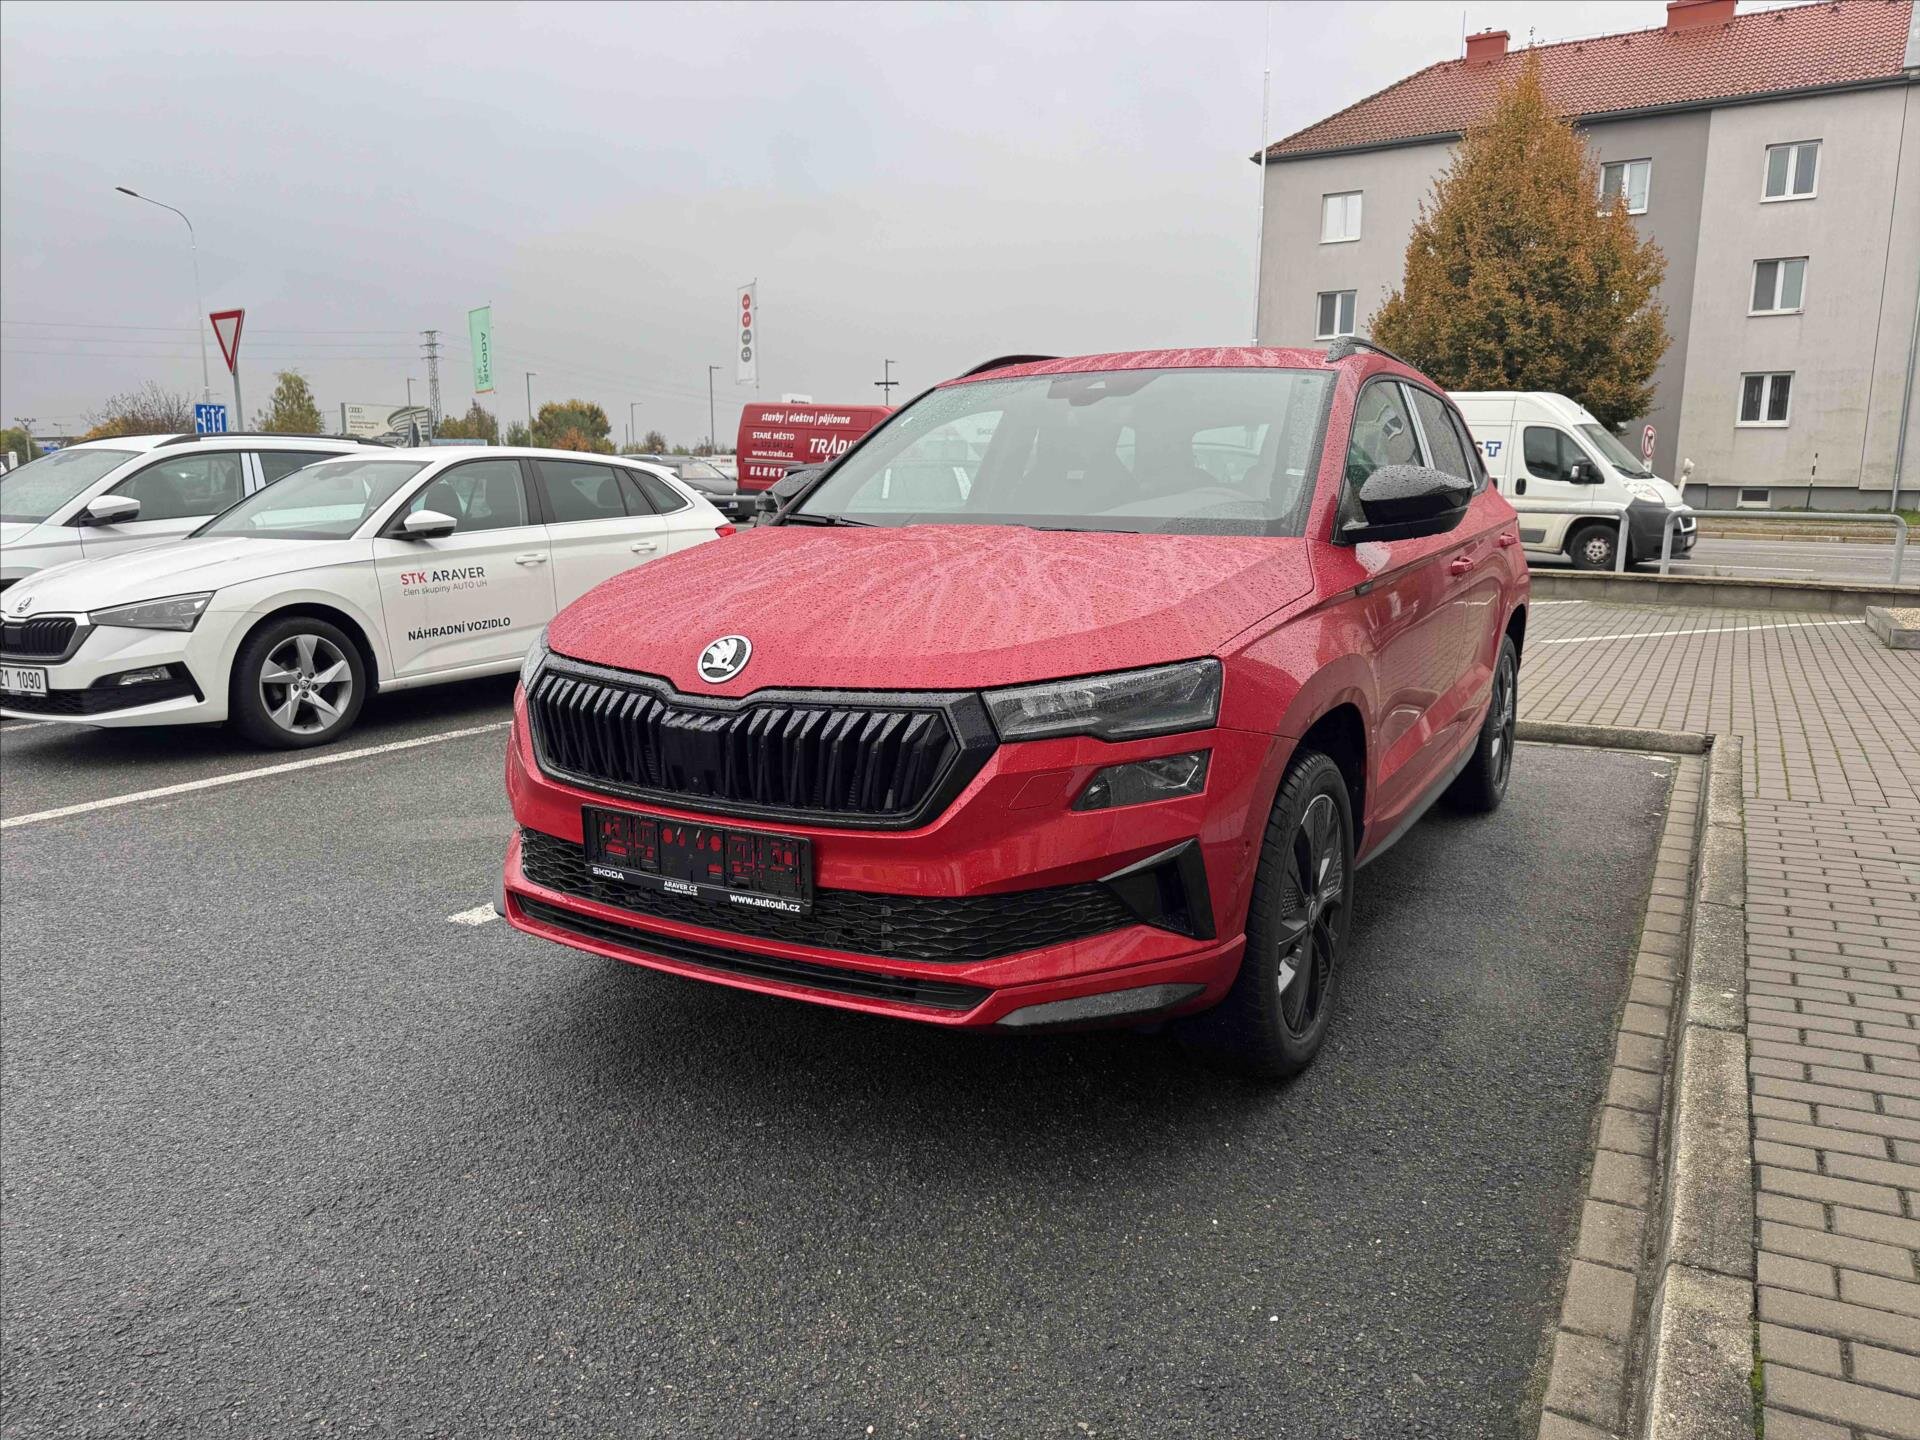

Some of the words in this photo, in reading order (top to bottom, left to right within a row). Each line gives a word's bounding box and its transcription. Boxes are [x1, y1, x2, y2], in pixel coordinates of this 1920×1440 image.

[761, 411, 784, 424] stavby
[789, 412, 814, 424] elektro
[810, 433, 857, 455] TRADI
[751, 450, 794, 458] www.tradix.cz
[400, 571, 428, 585] STK
[432, 566, 486, 583] ARAVER
[403, 587, 421, 597] člen
[422, 584, 451, 595] skupiny
[453, 582, 475, 591] AUTO
[408, 621, 466, 641] NÁHRADNÍ
[467, 617, 512, 632] VOZIDLO
[16, 670, 41, 689] 1090
[664, 880, 688, 891] ARAVER
[729, 894, 801, 913] www.autouh.cz
